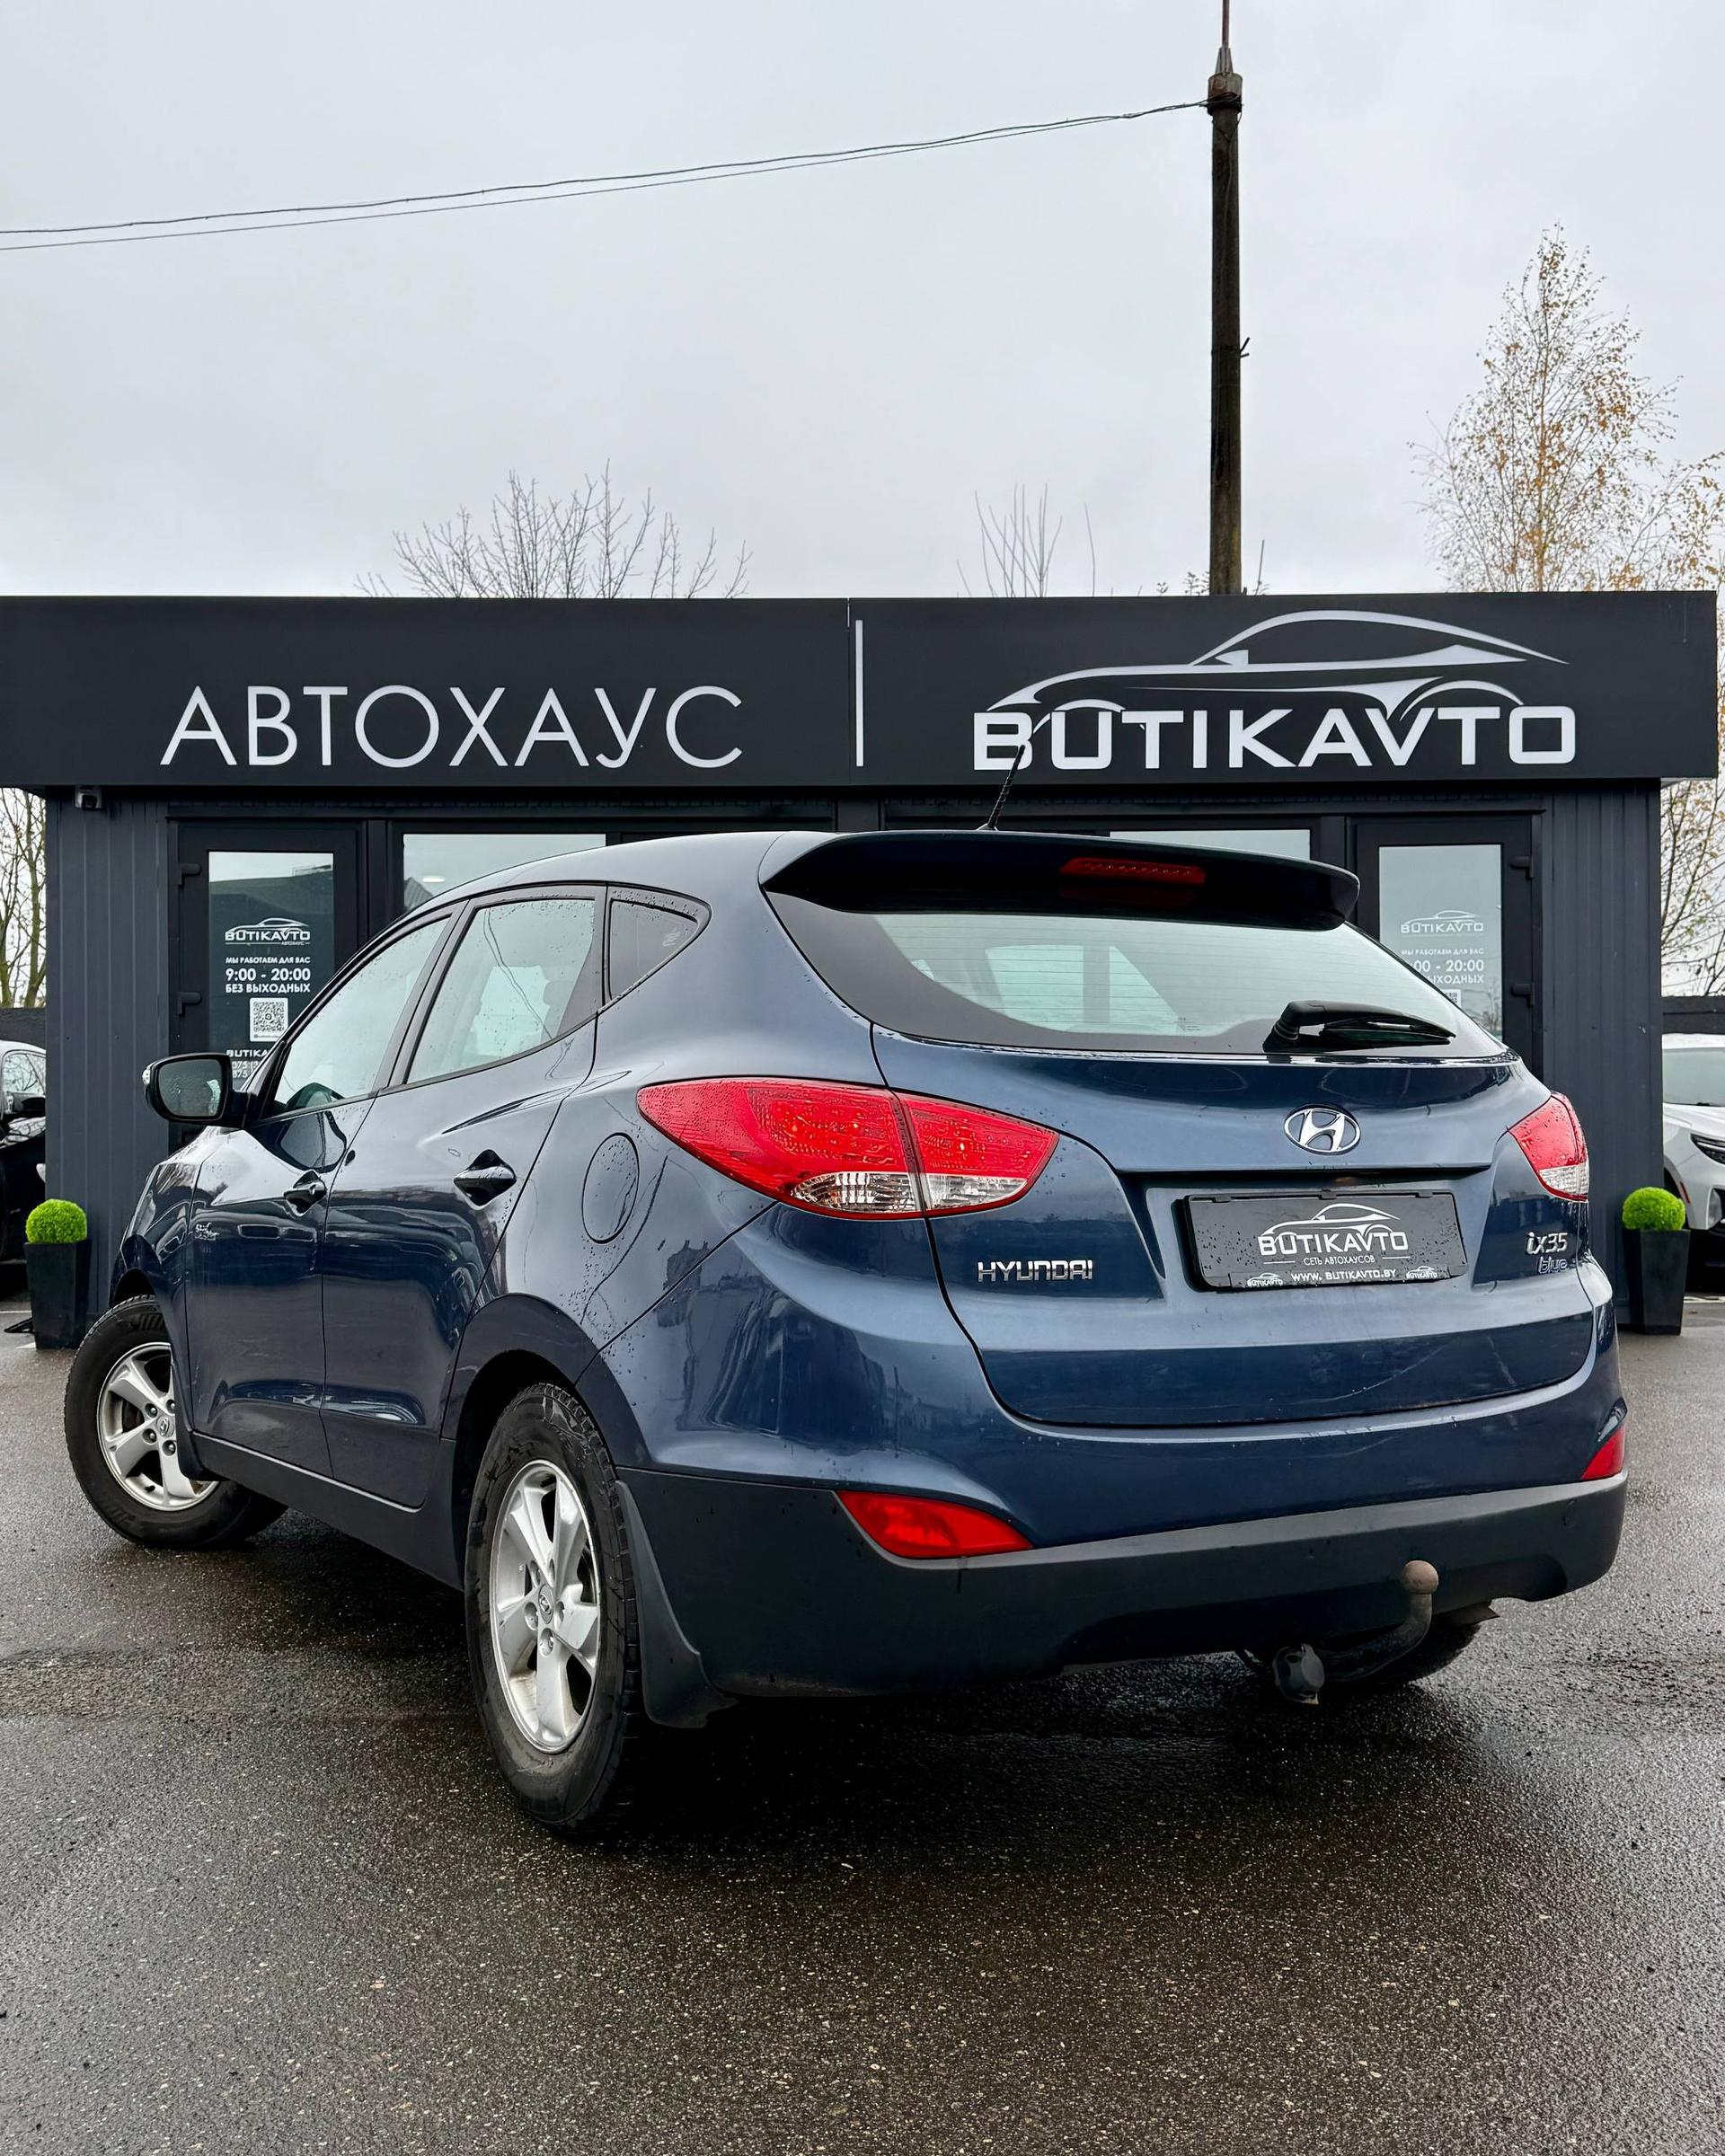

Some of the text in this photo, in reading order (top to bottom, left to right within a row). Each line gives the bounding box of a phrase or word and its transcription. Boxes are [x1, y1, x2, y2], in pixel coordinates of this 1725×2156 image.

[160, 684, 743, 769] АВТОХАУС
[973, 706, 1576, 771] BUTIKAVTO
[1401, 923, 1484, 934] BUTIKAVTO
[225, 931, 311, 941] BUTIKAVTO
[1411, 959, 1431, 973] :00
[1446, 959, 1484, 972] 20:00
[226, 968, 257, 982] 9:00
[270, 968, 311, 982] 20:00
[1427, 975, 1484, 985] ЫХОДНЫХ
[226, 983, 311, 994] БЕЗ ВЫХОДНЫХ
[226, 1049, 269, 1057] BUTIKA
[1258, 1232, 1410, 1256] BUTIKAVTO
[1526, 1232, 1569, 1255] ix35
[1303, 1255, 1376, 1266] СЕТЬ АВТОХАУСОВ
[1538, 1256, 1568, 1275] blue
[978, 1259, 1093, 1283] HYUNDAI
